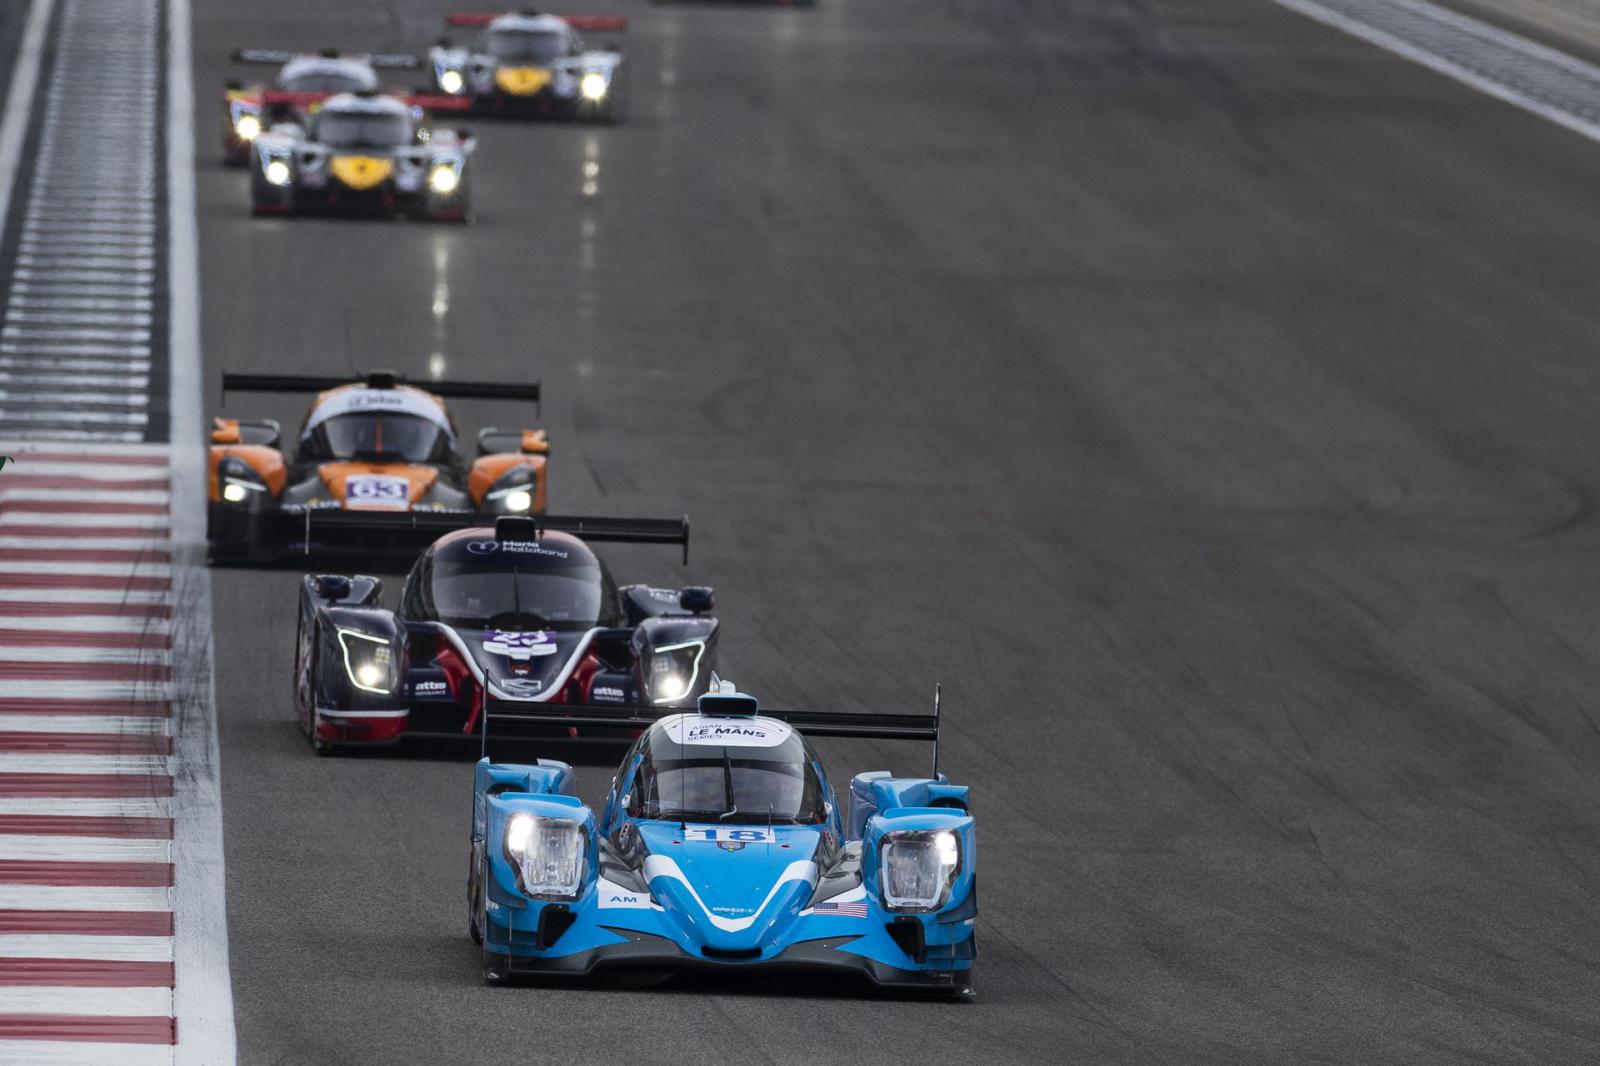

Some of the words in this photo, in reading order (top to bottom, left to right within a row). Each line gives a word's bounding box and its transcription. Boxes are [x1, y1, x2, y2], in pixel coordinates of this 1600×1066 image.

[353, 480, 403, 499] 63
[502, 540, 539, 548] Maria
[492, 628, 548, 647] 23
[689, 728, 709, 737] LE
[714, 727, 766, 738] MANS
[692, 829, 767, 841] 18
[610, 895, 637, 903] AM
